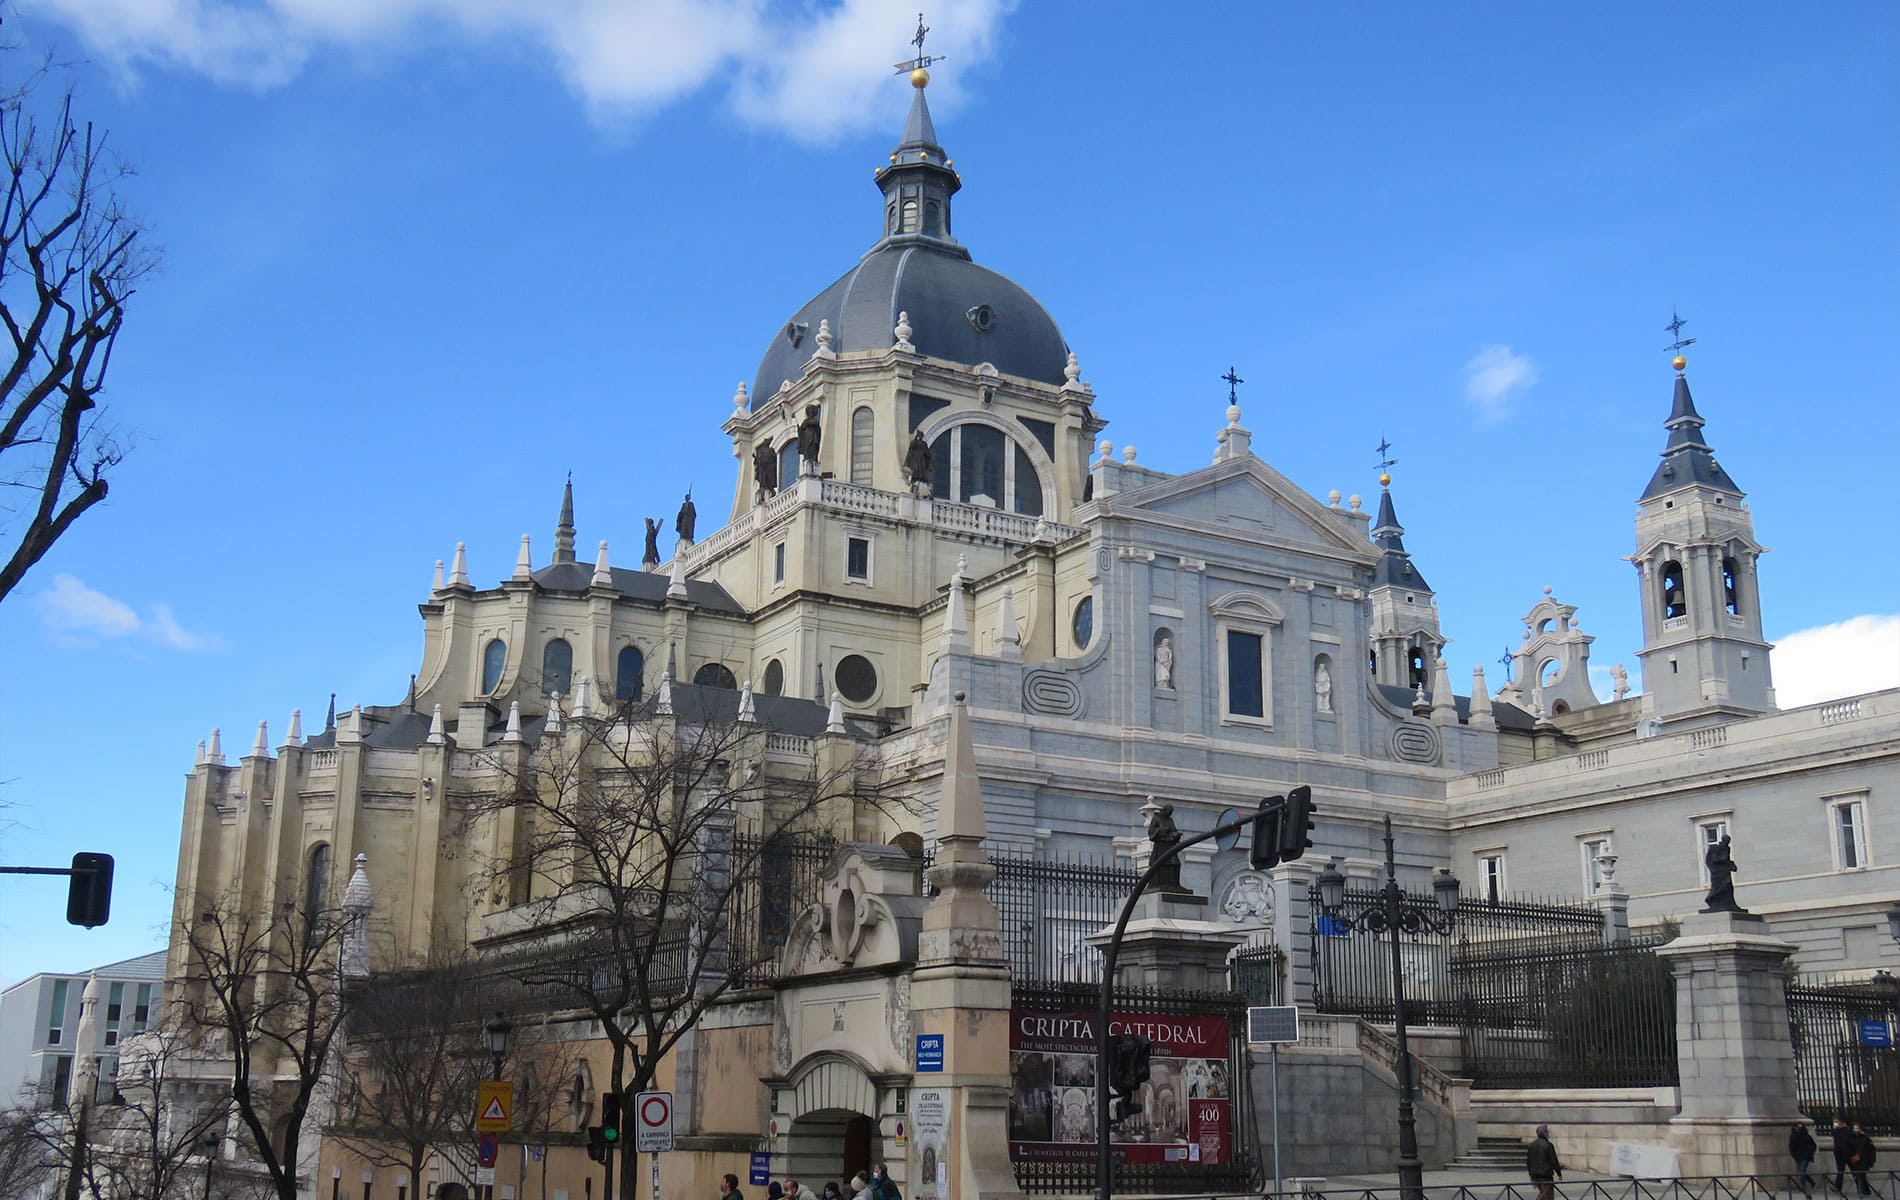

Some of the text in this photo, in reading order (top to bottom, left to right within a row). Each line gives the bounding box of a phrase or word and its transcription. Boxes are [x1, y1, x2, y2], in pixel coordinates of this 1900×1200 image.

[1020, 1017, 1207, 1044] CRIPTA CATEDRAL
[920, 1040, 939, 1049] CRIPTA
[1034, 1043, 1053, 1051] MOST
[1054, 1044, 1098, 1053] SPECTACULAR
[921, 1093, 940, 1101] CRIPTA
[1199, 1109, 1220, 1122] 400
